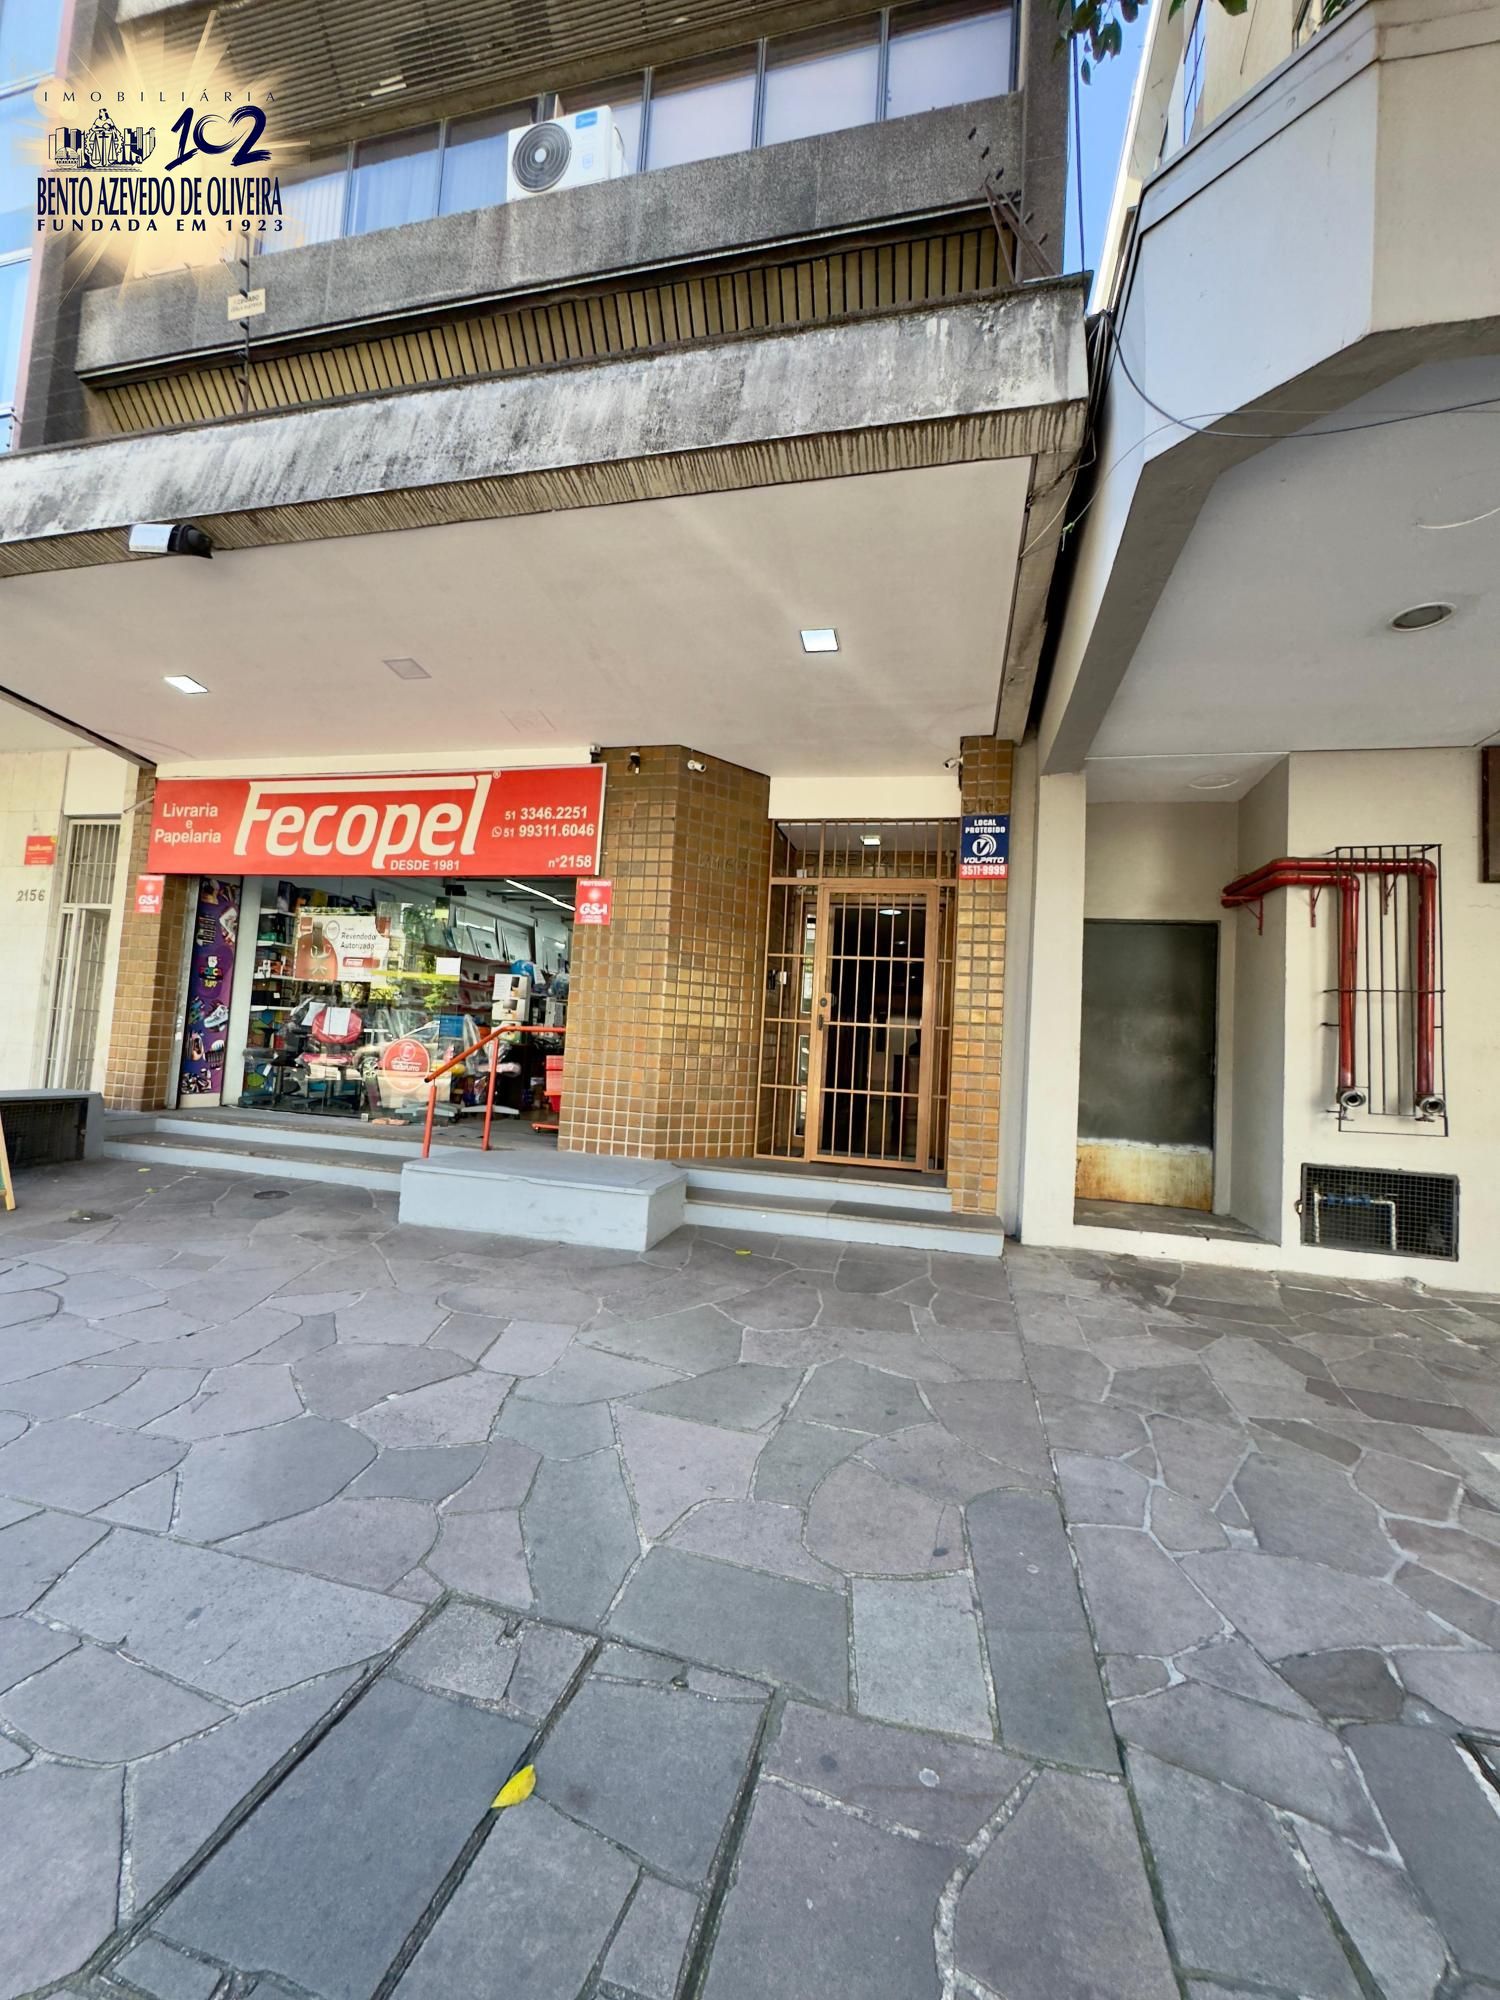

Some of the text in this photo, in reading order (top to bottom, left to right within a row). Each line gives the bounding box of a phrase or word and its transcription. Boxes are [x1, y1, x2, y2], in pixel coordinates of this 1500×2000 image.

[162, 802, 218, 818] Livraria
[504, 806, 588, 821] 51 3346.2251
[185, 820, 193, 829] e
[233, 775, 493, 869] Fecopel
[154, 829, 221, 845] Papelaria
[503, 824, 595, 838] 51 99311.6046
[964, 826, 1006, 834] PROTEGIDO
[389, 858, 460, 871] DESDE 1981
[962, 865, 1006, 876] 3511-9999
[16, 888, 46, 902] 2156
[341, 932, 377, 941] Revendedor
